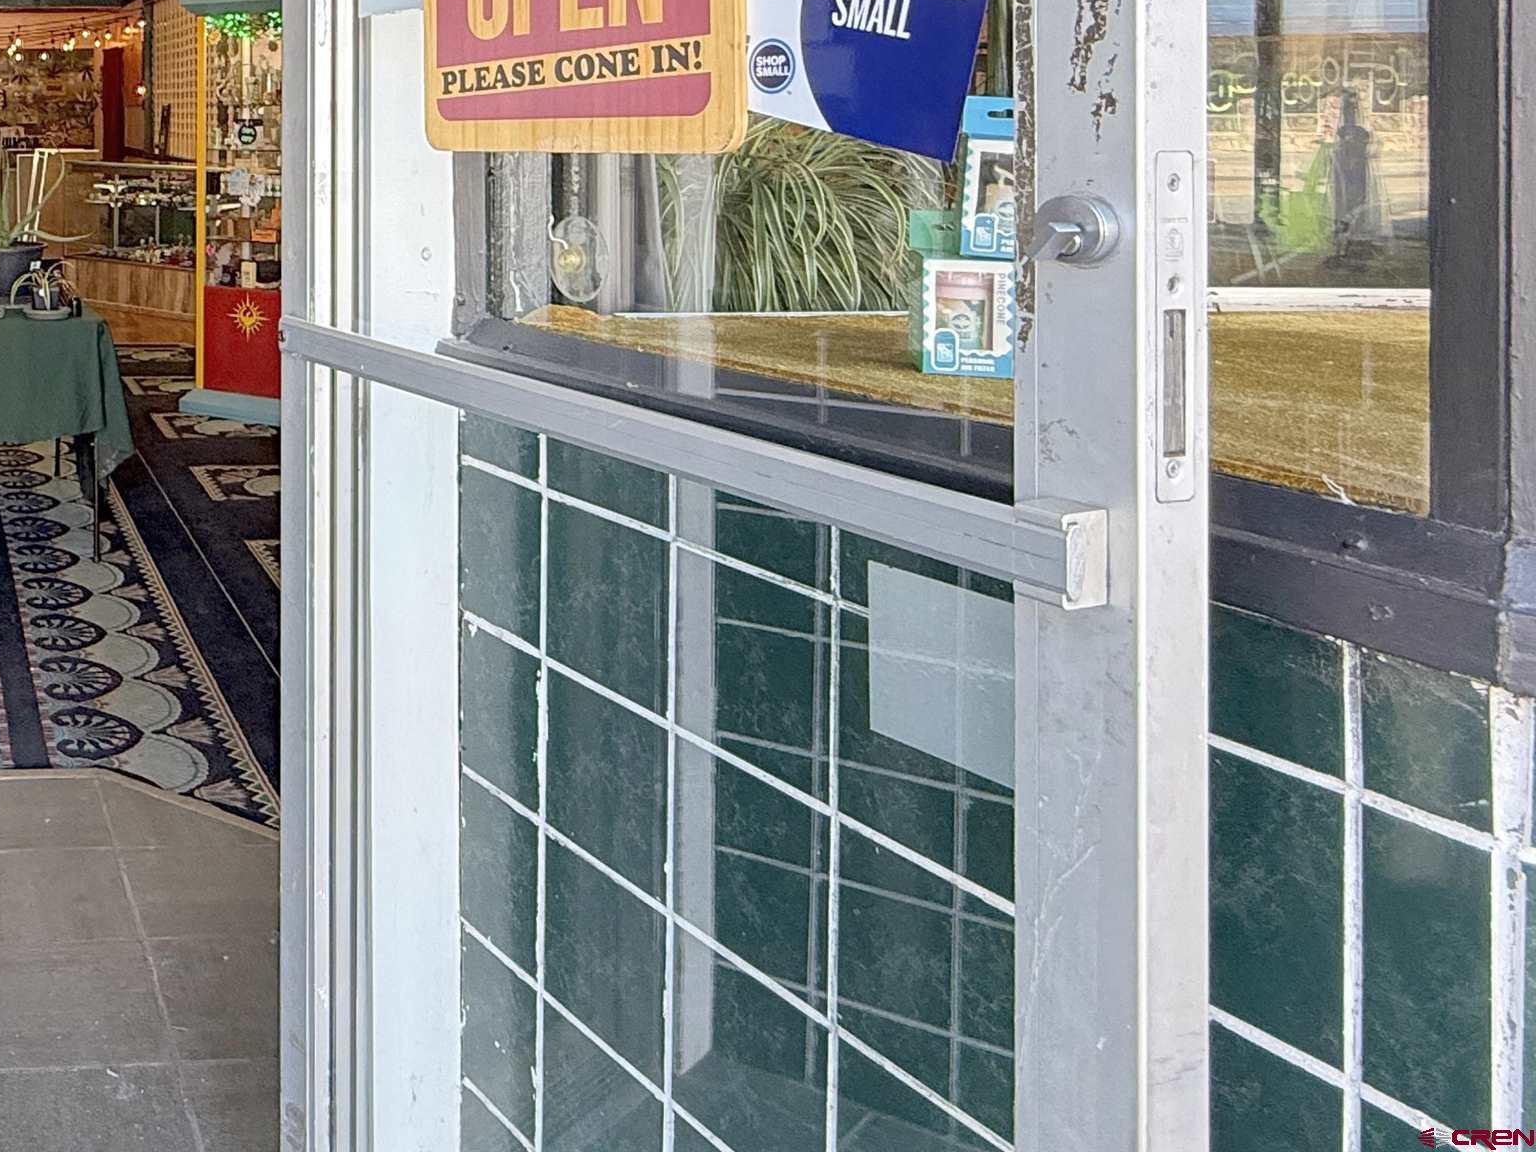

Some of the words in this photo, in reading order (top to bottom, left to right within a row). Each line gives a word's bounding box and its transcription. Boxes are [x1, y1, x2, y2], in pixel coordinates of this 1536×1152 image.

[442, 59, 545, 95] PLEASE
[554, 48, 640, 83] CONE
[651, 40, 702, 73] IN!
[756, 55, 786, 66] SHOP
[756, 66, 791, 77] SMALL
[997, 273, 1006, 326] PINECONE
